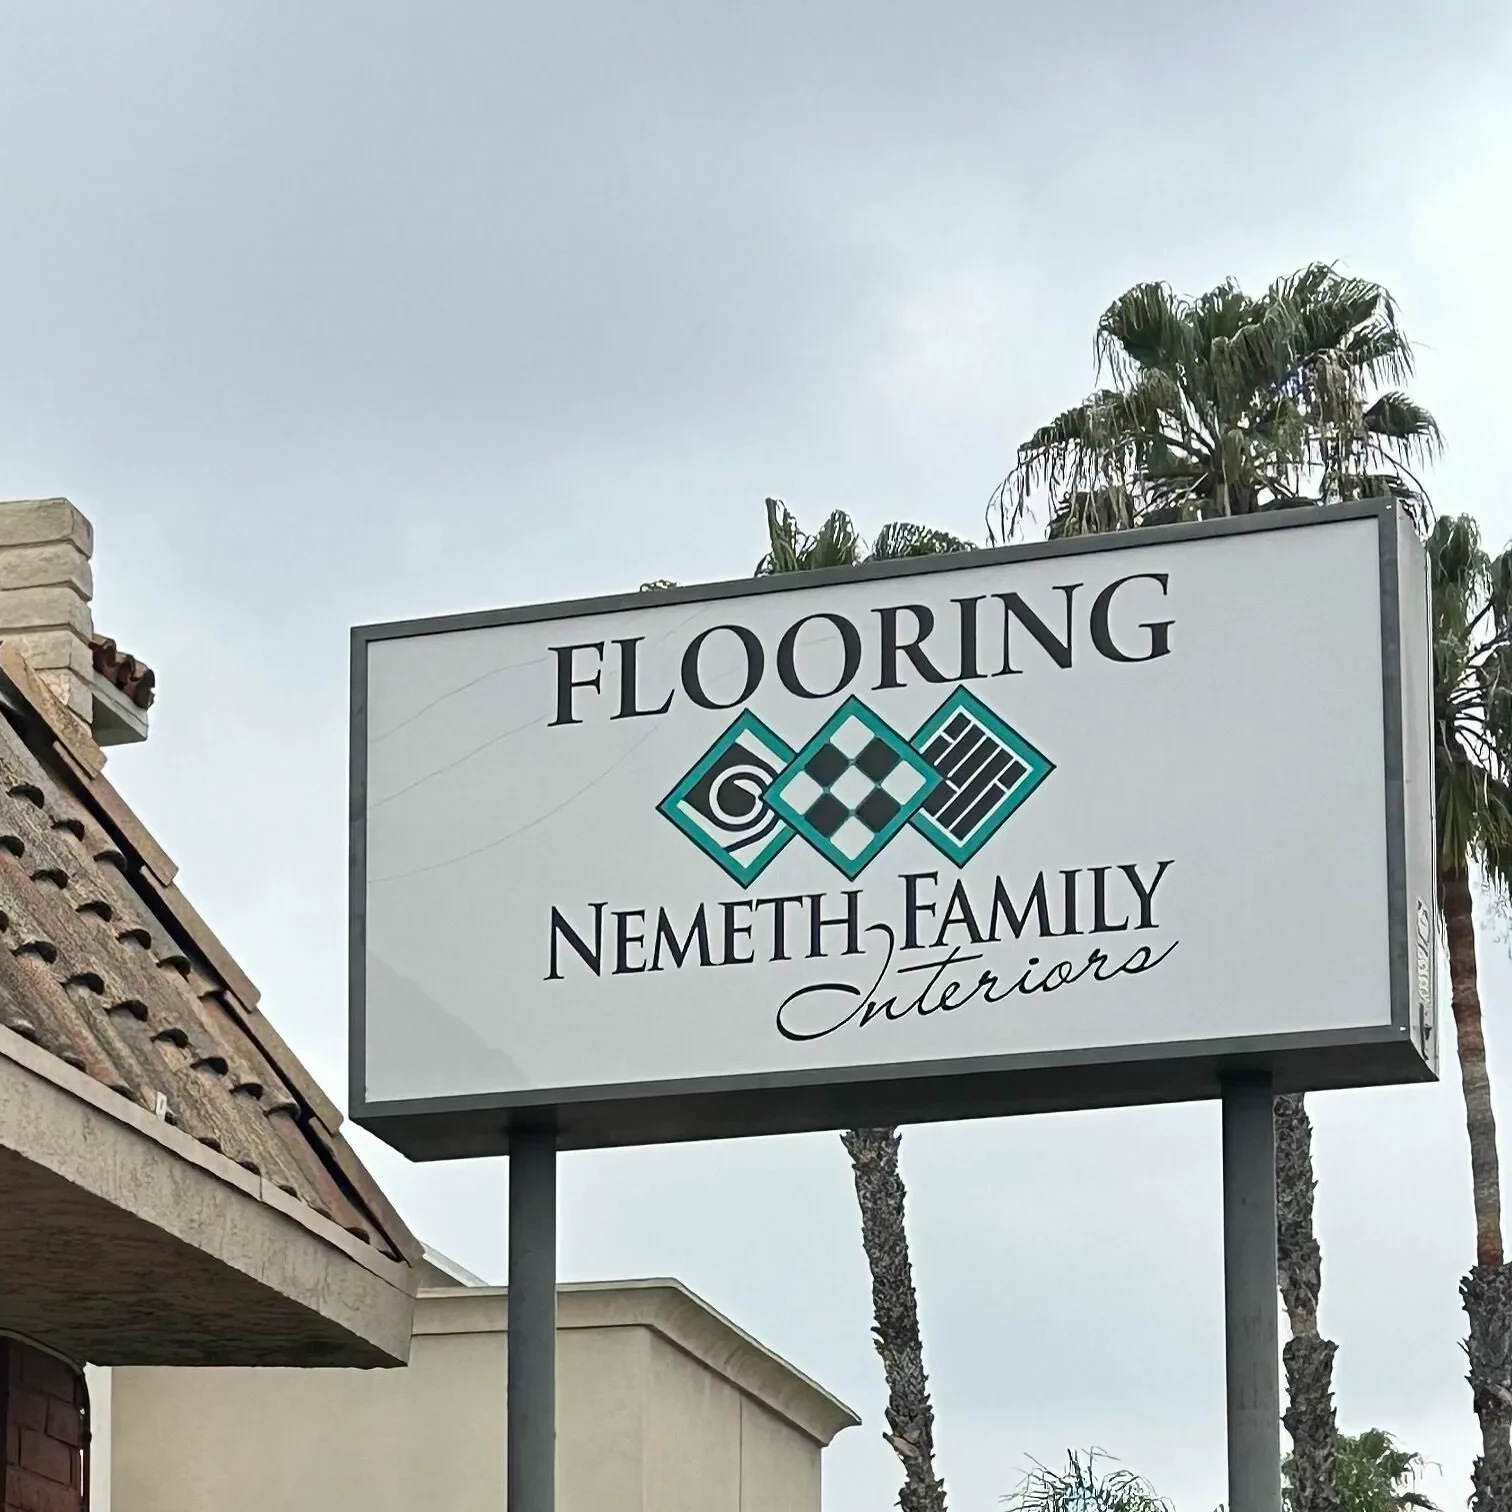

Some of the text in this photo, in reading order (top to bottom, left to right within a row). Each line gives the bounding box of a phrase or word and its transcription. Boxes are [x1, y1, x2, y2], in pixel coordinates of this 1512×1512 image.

[546, 572, 1175, 728] FLOORING
[544, 859, 1176, 981] NEMETH FAMILY
[775, 923, 1179, 1042] Interiors
